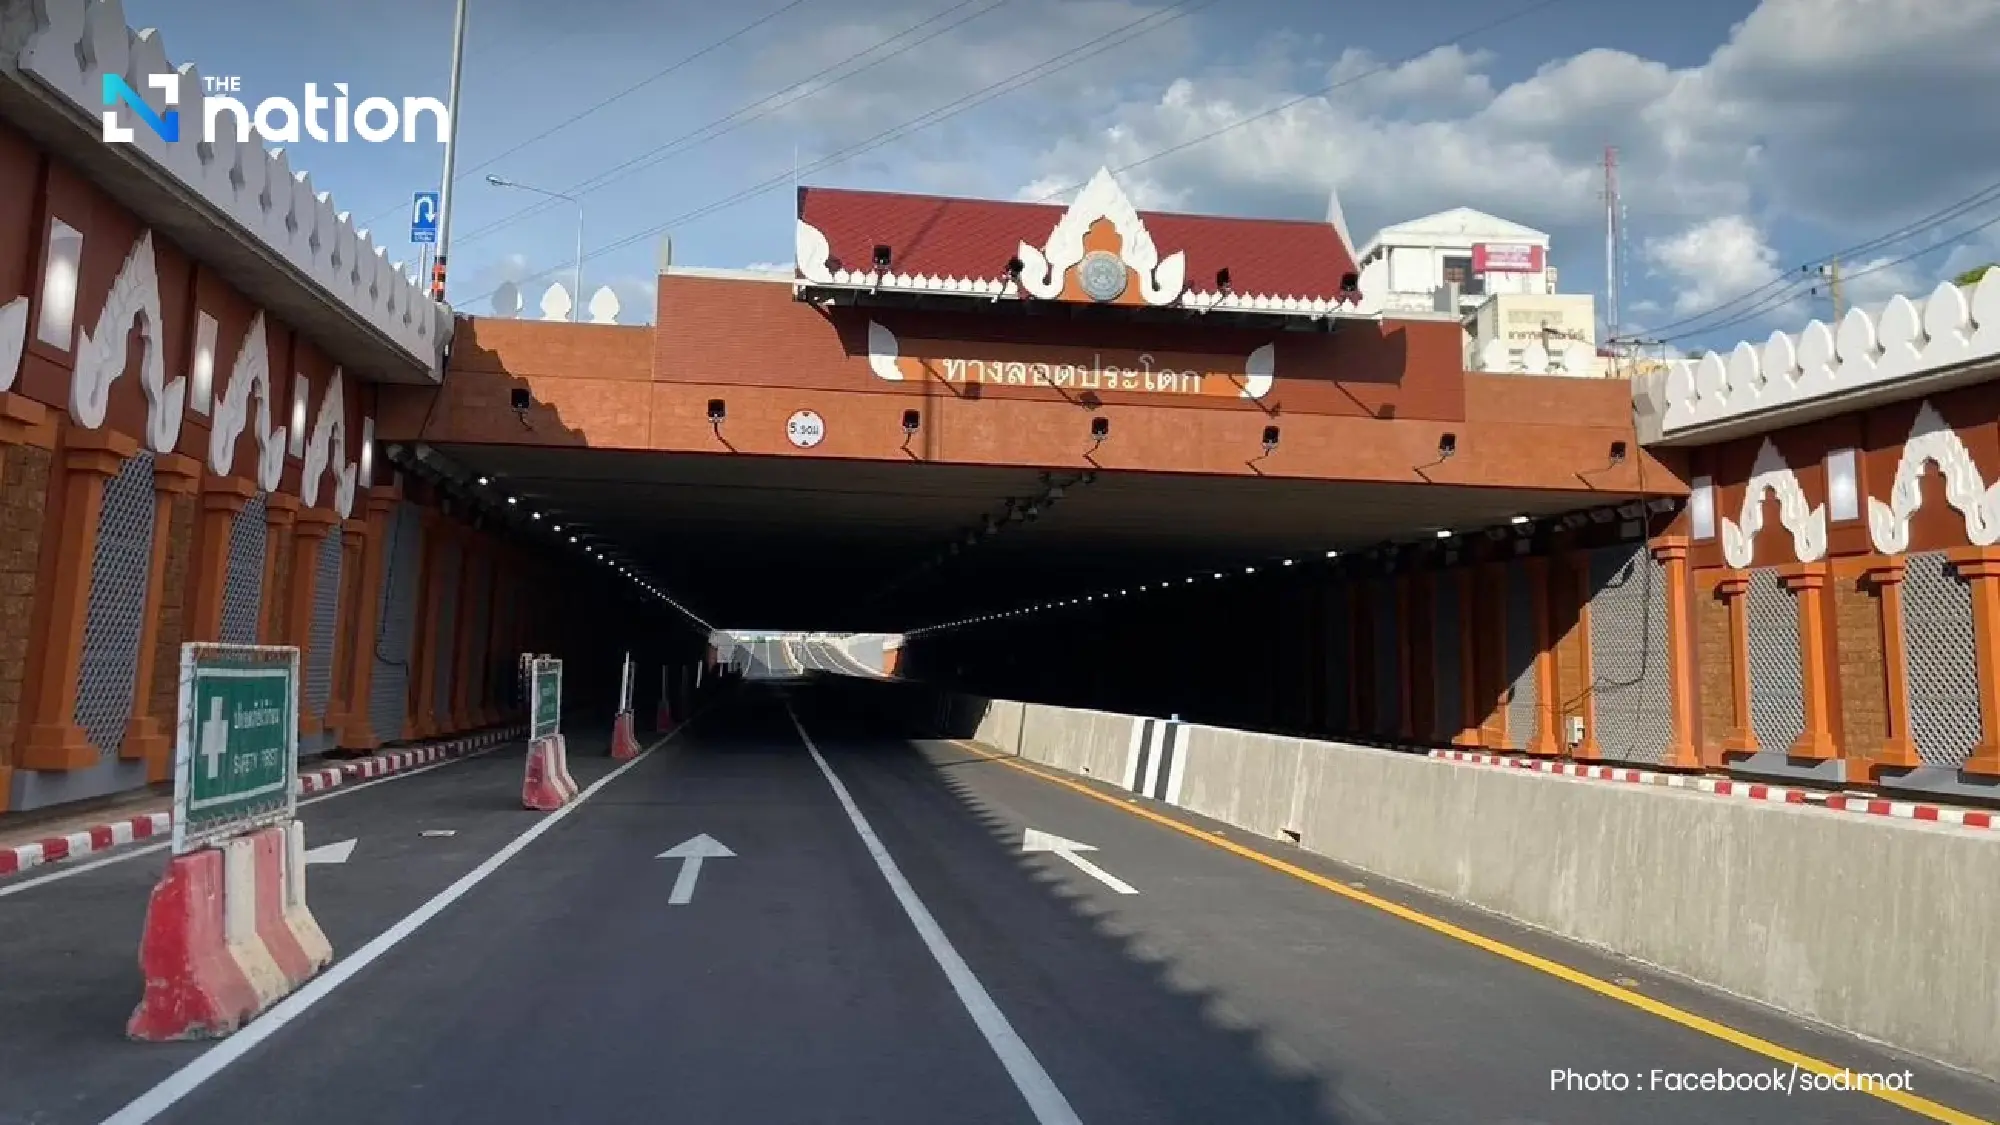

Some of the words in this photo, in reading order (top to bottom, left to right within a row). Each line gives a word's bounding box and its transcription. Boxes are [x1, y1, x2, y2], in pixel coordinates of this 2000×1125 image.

[942, 353, 1202, 394] ทางลอดประโดก
